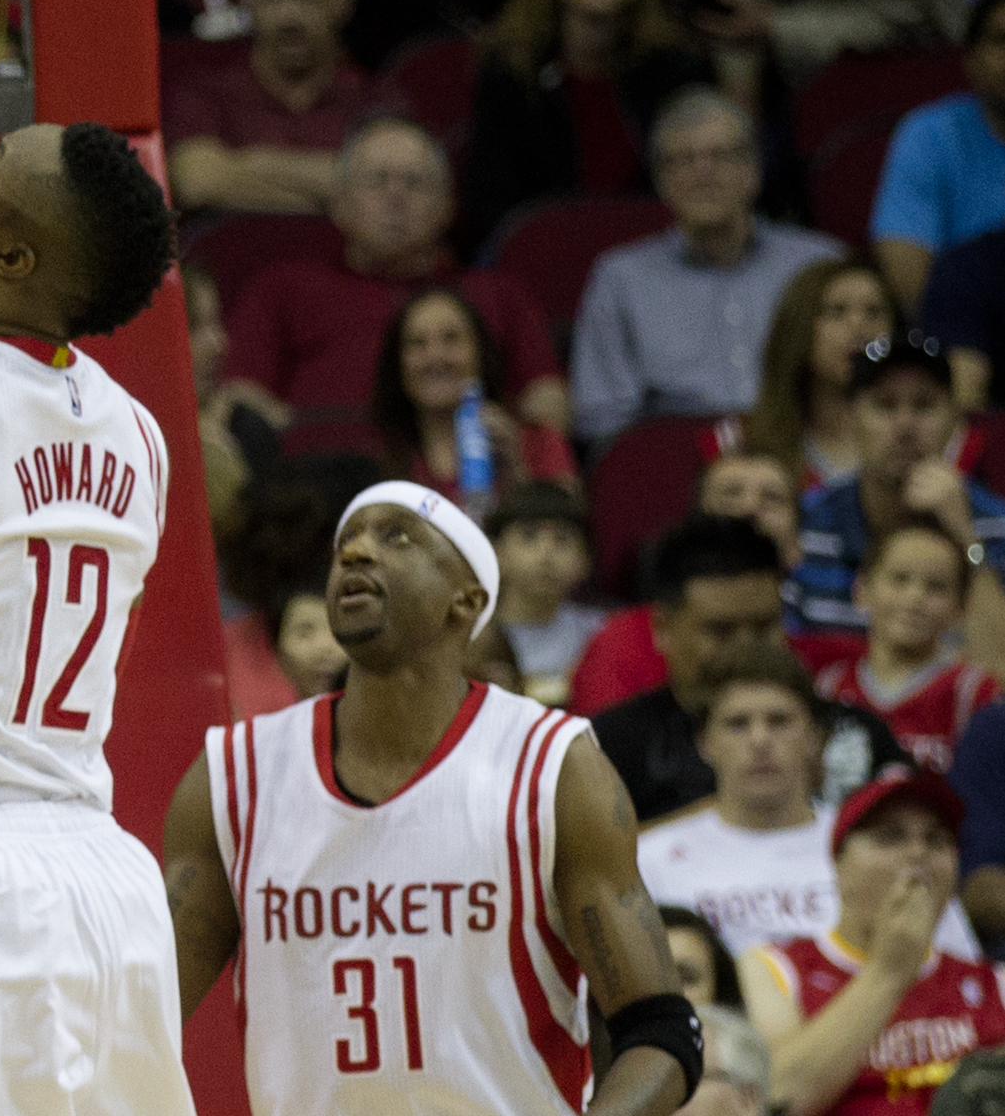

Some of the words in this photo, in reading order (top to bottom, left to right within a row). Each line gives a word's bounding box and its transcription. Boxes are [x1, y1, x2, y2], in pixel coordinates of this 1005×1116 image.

[14, 442, 136, 519] HOWARD
[11, 536, 110, 732] 12
[256, 877, 498, 944] ROCKETS
[697, 888, 826, 934] ROCKE
[333, 955, 424, 1074] 31
[869, 1014, 979, 1072] USTON
